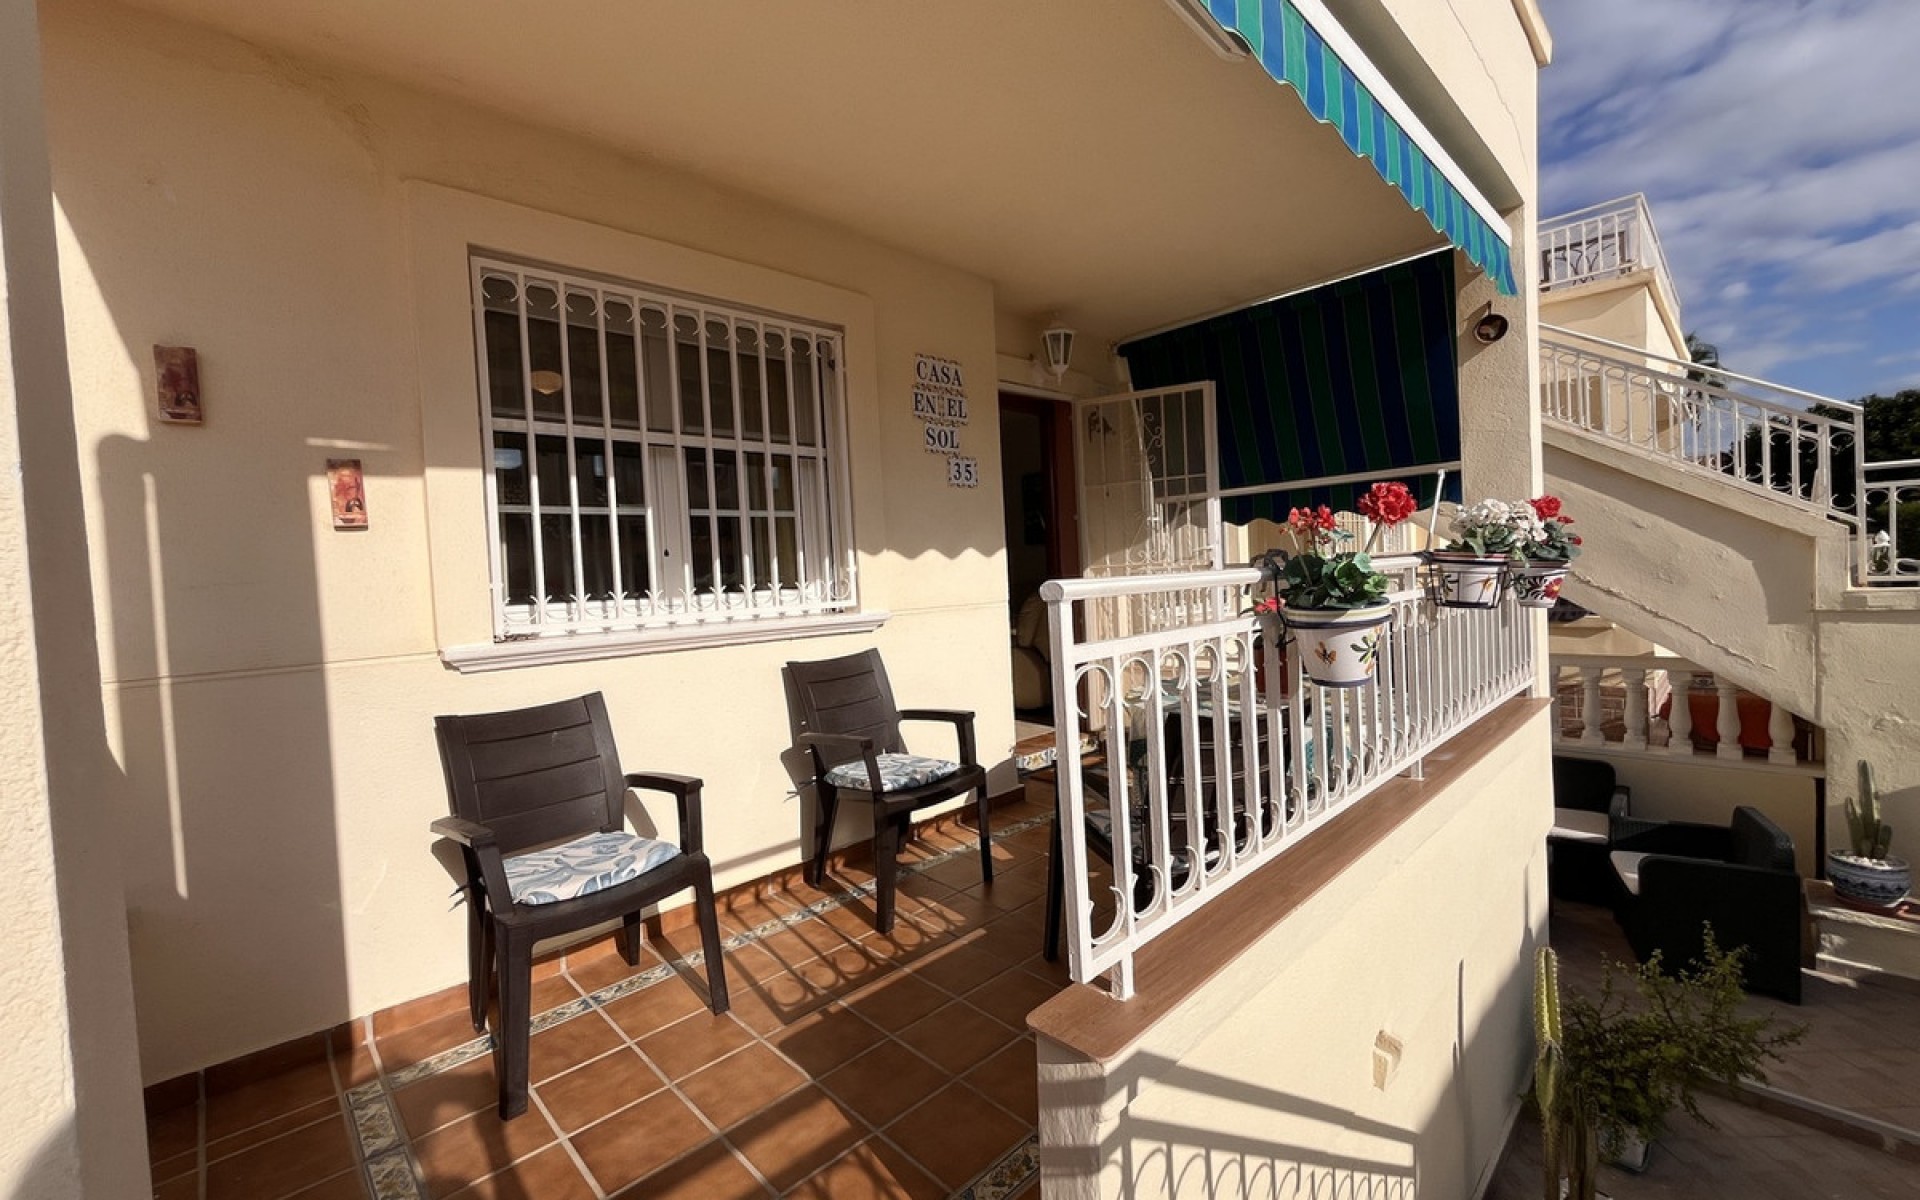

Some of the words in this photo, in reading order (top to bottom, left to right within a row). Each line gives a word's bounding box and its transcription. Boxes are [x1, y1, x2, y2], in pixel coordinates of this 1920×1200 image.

[916, 360, 962, 387] CASA
[914, 392, 936, 414] EN
[948, 398, 967, 419] EL
[926, 427, 959, 449] SOL
[953, 462, 972, 481] 35
